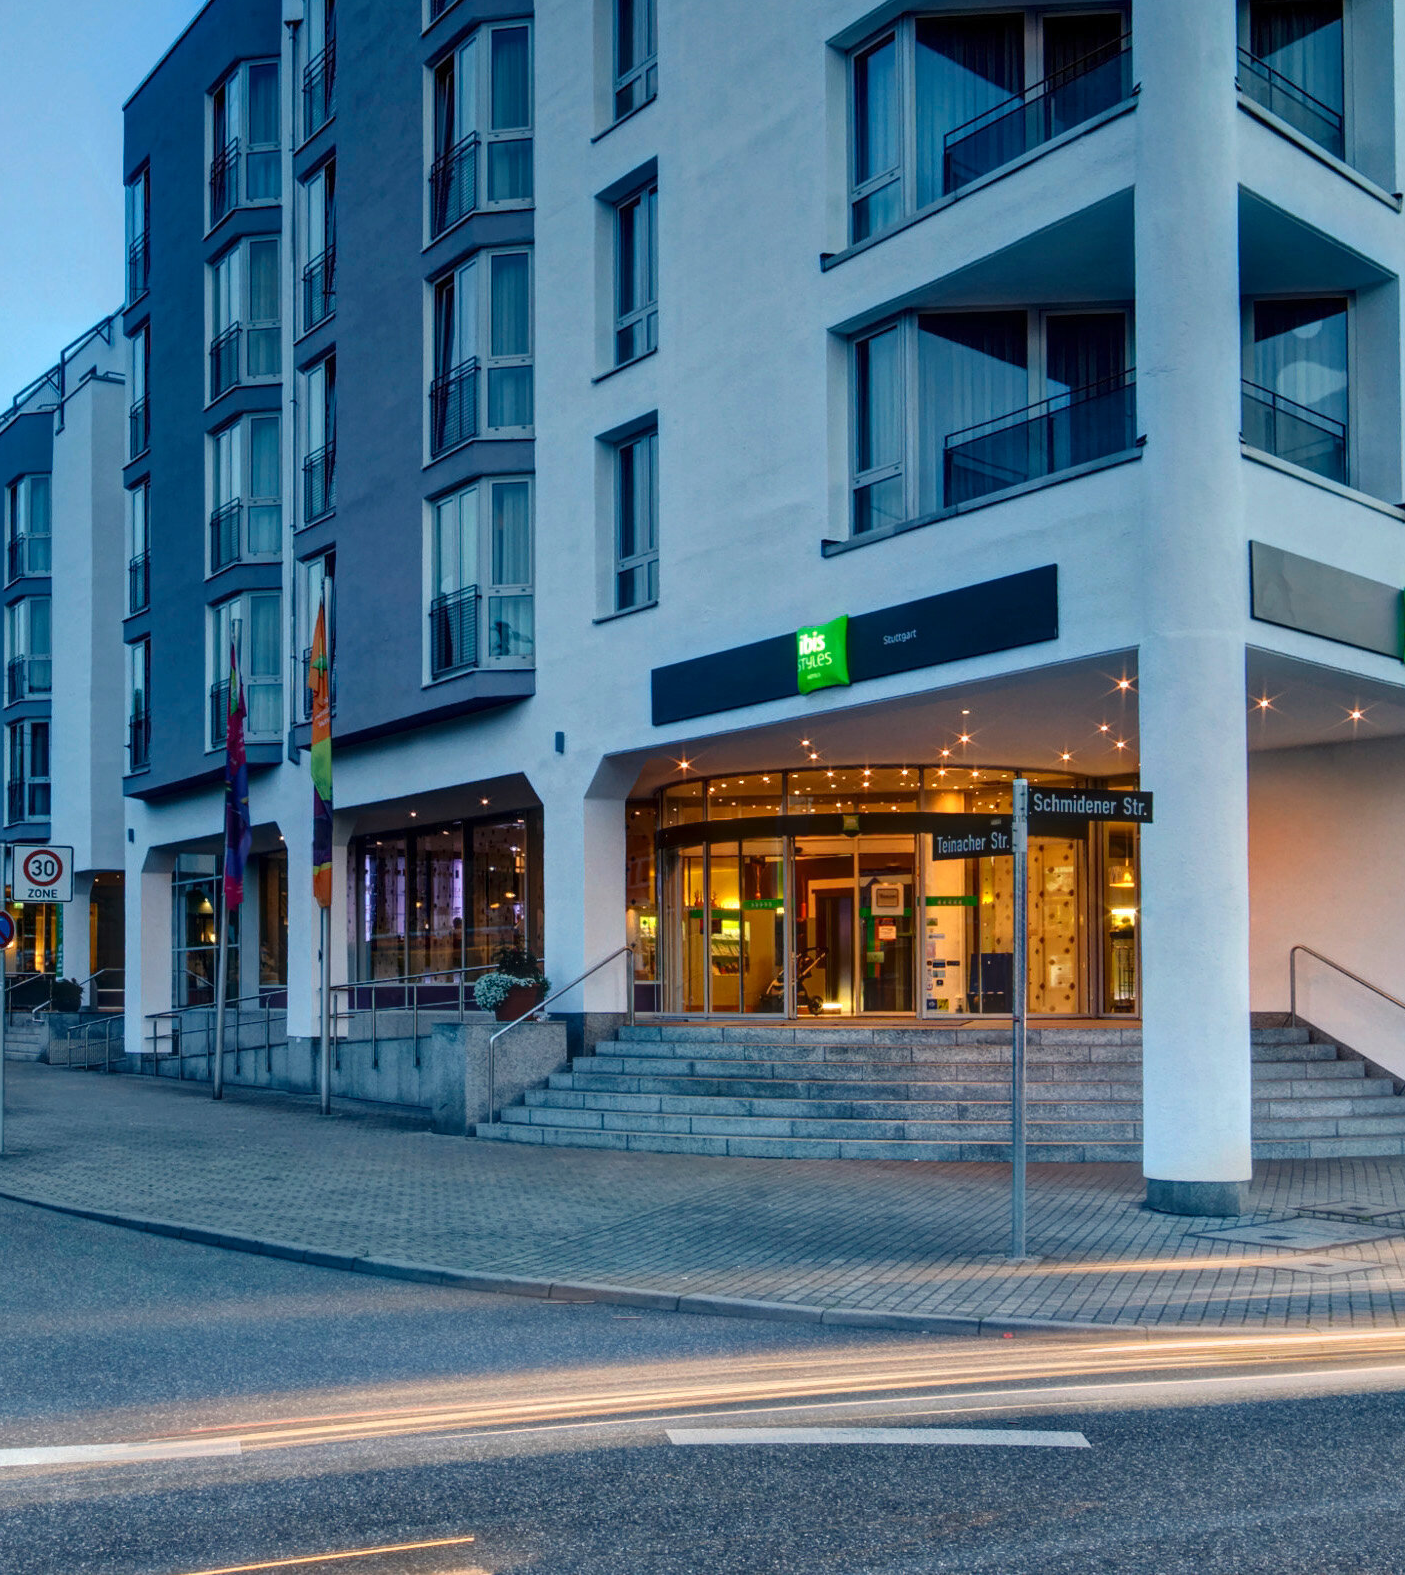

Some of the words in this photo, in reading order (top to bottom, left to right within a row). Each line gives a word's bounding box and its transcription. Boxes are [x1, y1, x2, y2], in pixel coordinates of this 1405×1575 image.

[799, 631, 826, 656] ibis
[882, 629, 917, 645] Stuttgart
[1033, 792, 1117, 815] Schmidener
[1123, 797, 1148, 816] Str.
[937, 834, 987, 854] Teinacher
[990, 832, 1010, 849] Str.
[31, 859, 55, 877] 30
[28, 888, 58, 899] ZONE
